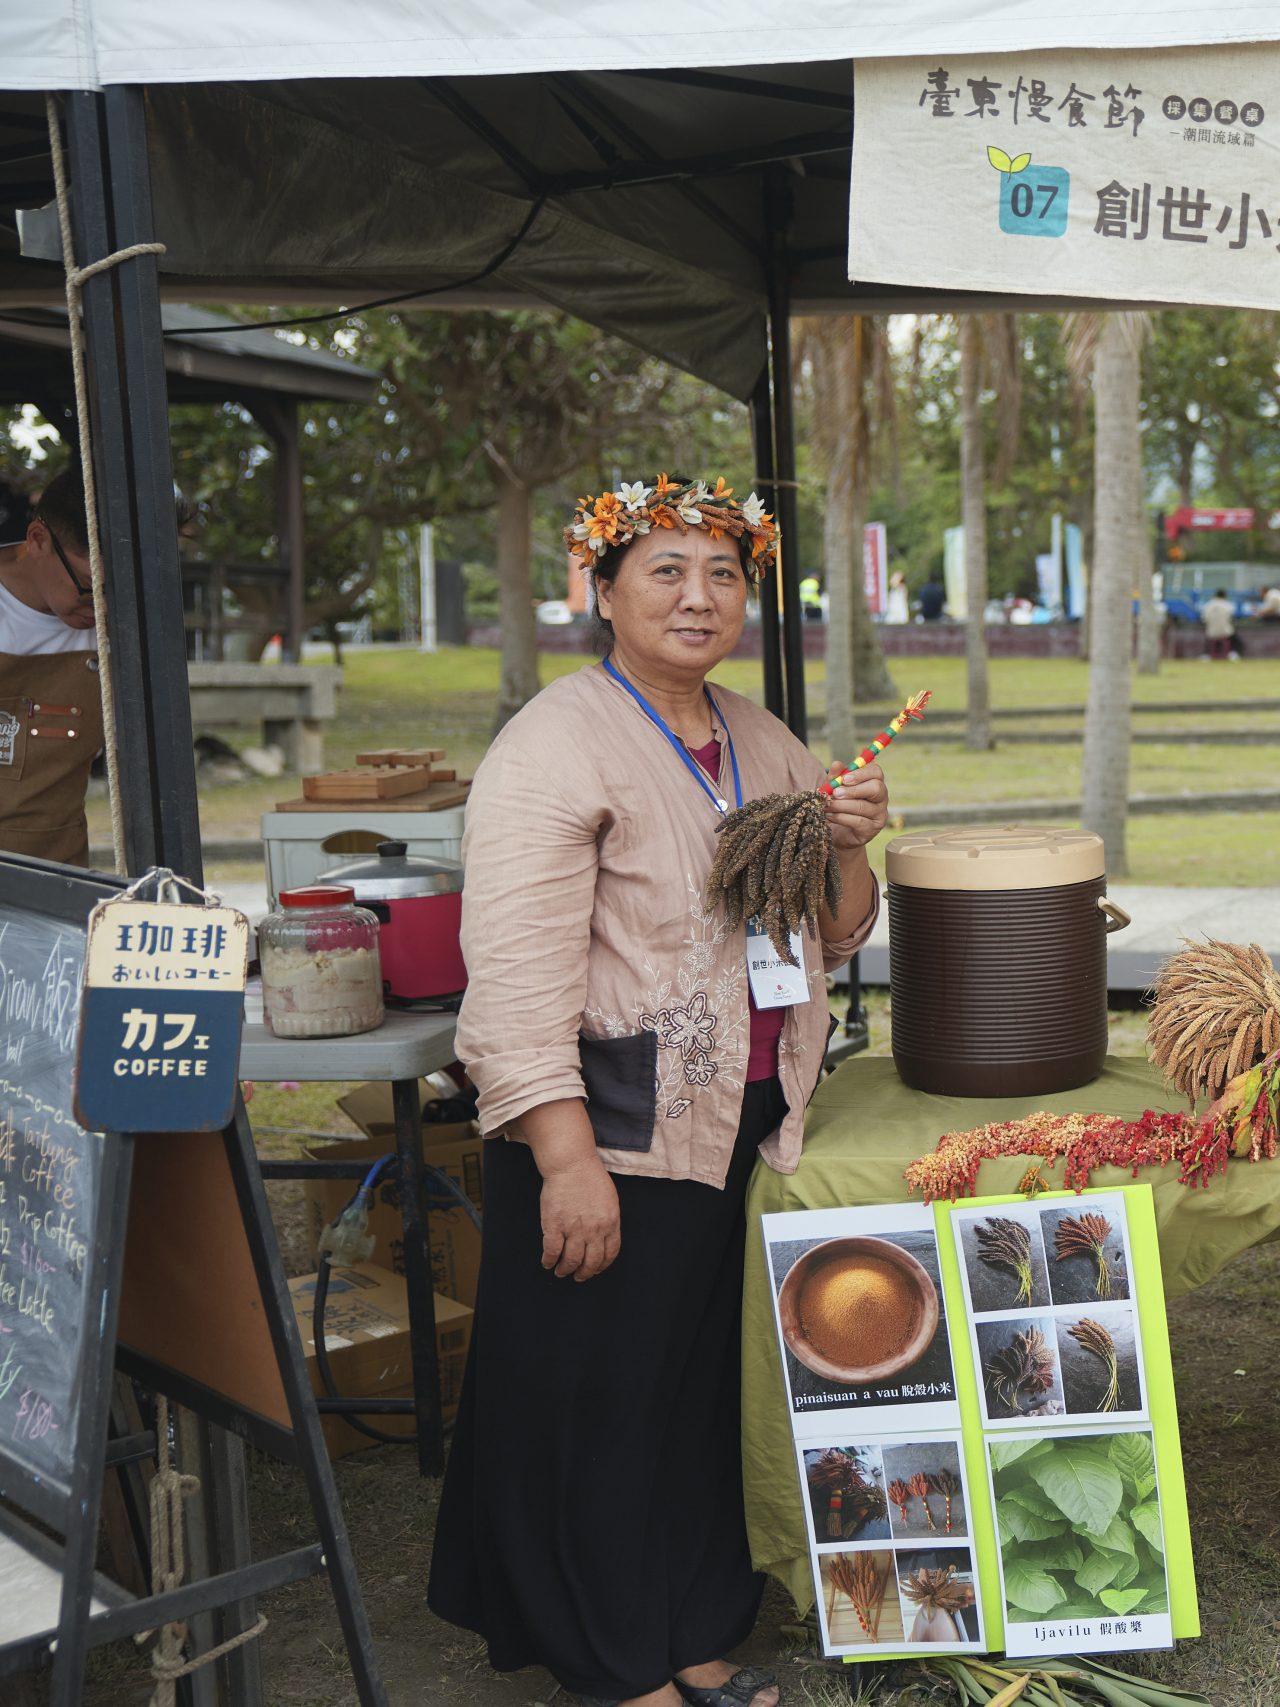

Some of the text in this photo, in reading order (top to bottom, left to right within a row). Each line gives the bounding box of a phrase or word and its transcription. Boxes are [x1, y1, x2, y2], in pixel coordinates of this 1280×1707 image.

[918, 66, 1145, 138] 臺東慢食節
[1165, 98, 1260, 123] 採集餐桌
[1010, 181, 1060, 220] 07
[115, 920, 228, 959] 珈琲
[121, 1008, 210, 1052] カフェ
[113, 1058, 209, 1077] COFFEE
[794, 1389, 858, 1408] pinaisuan
[863, 1389, 872, 1400] a
[875, 1387, 899, 1399] vau
[1034, 1624, 1092, 1642] ljavilu
